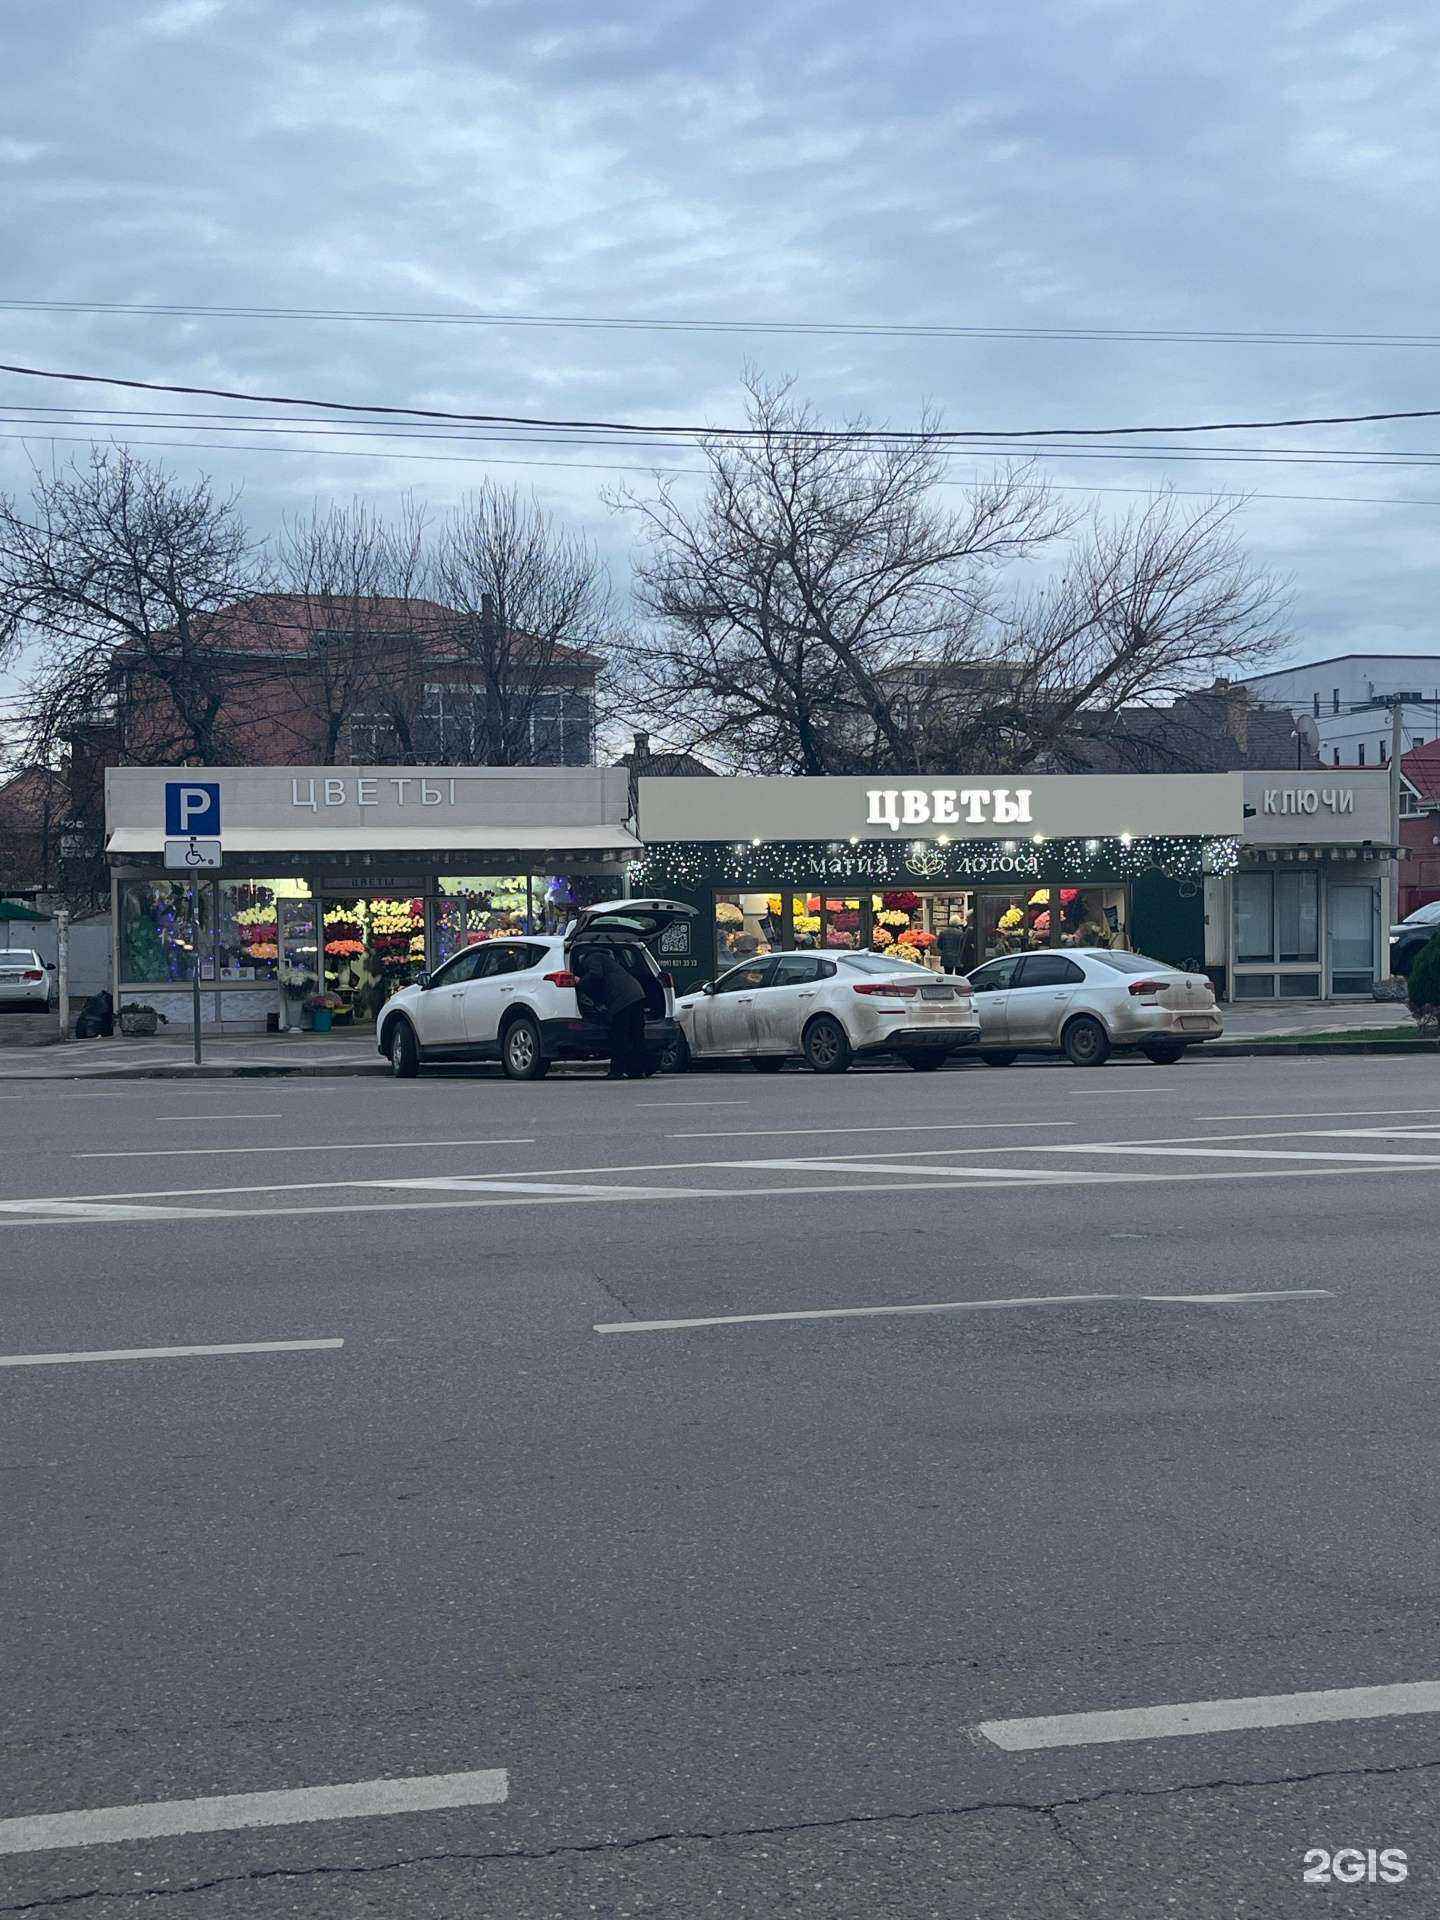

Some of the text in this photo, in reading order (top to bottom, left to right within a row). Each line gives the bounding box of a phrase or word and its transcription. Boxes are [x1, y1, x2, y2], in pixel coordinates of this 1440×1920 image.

[180, 788, 211, 830] P
[291, 779, 456, 813] ЦВЕТЫ
[866, 789, 1033, 831] ЦВЕТЫ
[1263, 789, 1354, 814] КЛЮЧИ
[809, 855, 1039, 874] магия лотоса
